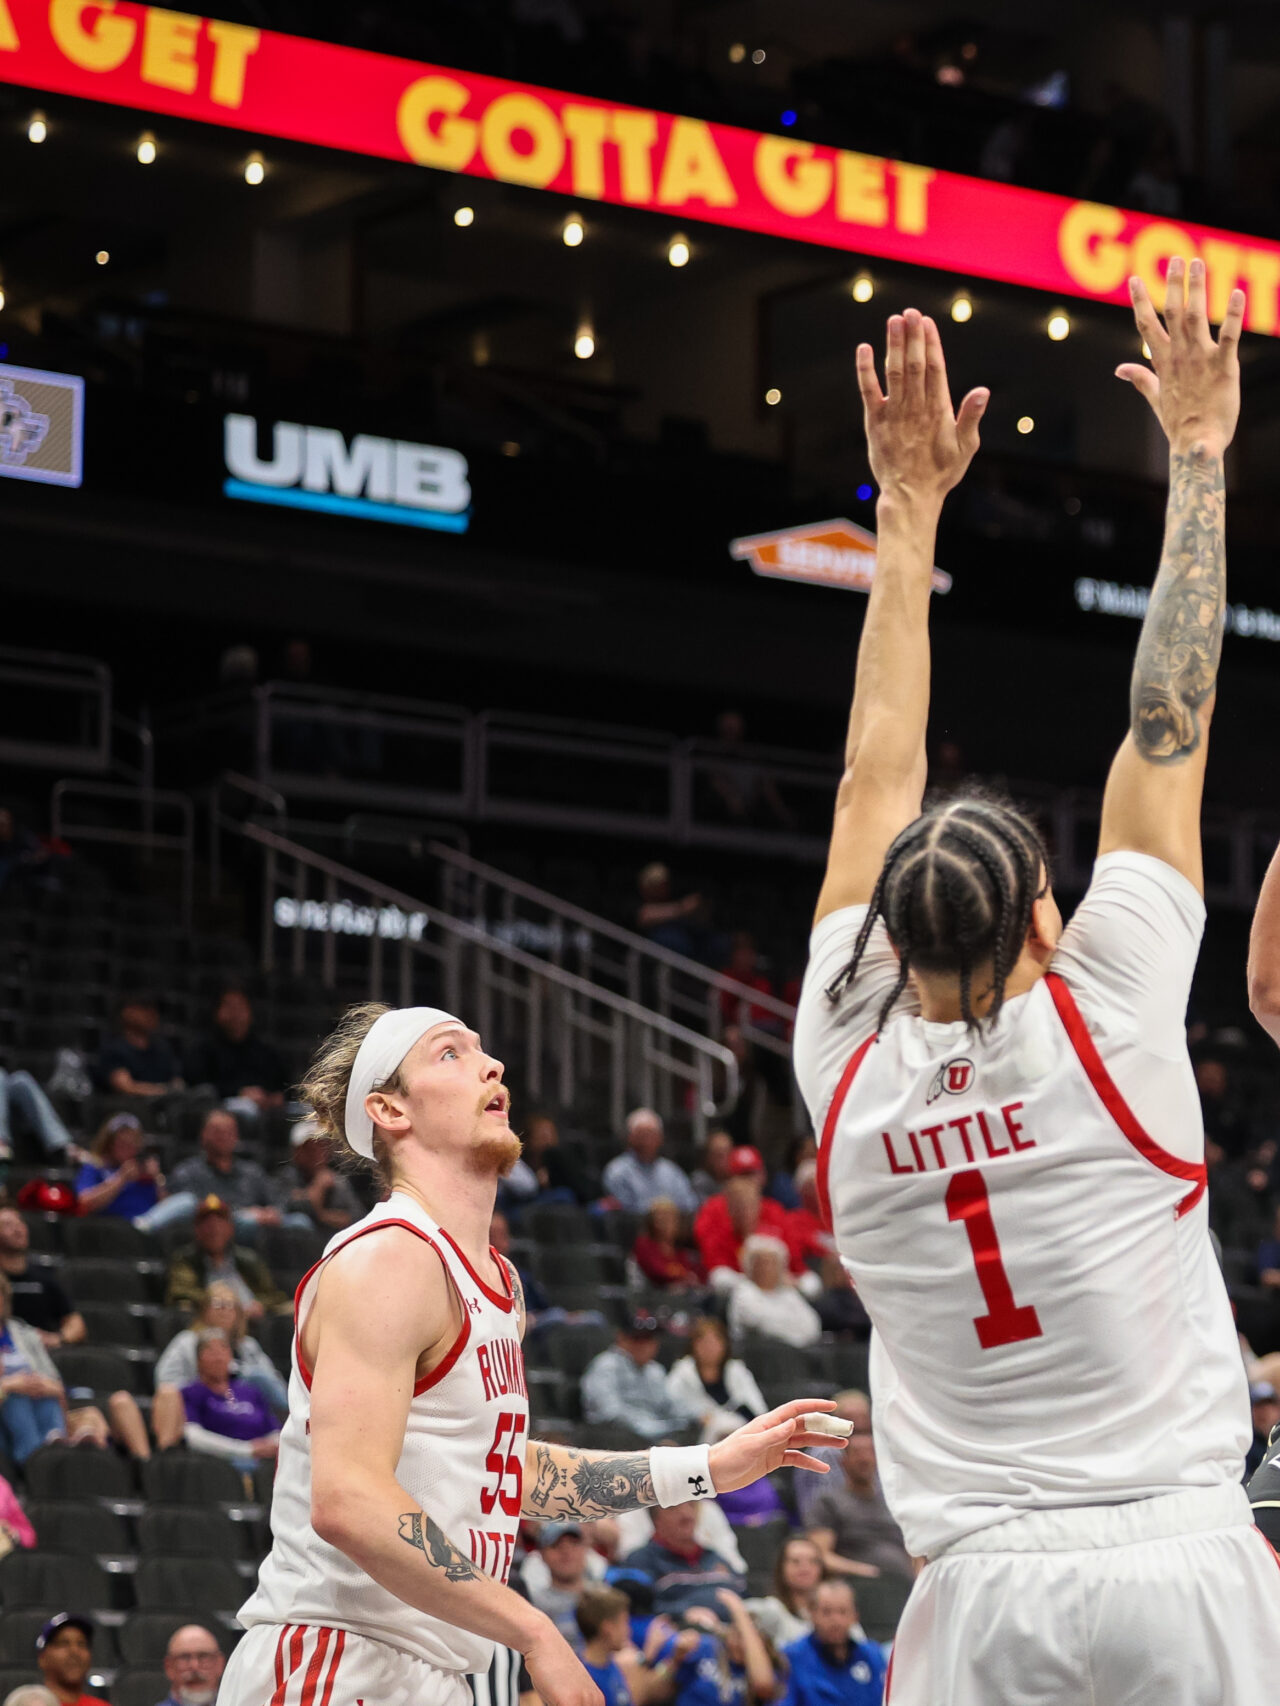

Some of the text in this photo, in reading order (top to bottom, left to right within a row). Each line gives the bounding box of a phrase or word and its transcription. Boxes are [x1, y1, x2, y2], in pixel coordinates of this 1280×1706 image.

[48, 0, 260, 109] GET
[397, 75, 935, 235] GOTTA GET
[224, 412, 472, 514] UMB
[949, 1065, 971, 1090] U
[881, 1101, 1037, 1175] LITTLE
[944, 1168, 1043, 1350] 1
[480, 1412, 526, 1518] 55
[469, 1528, 515, 1585] UTE
